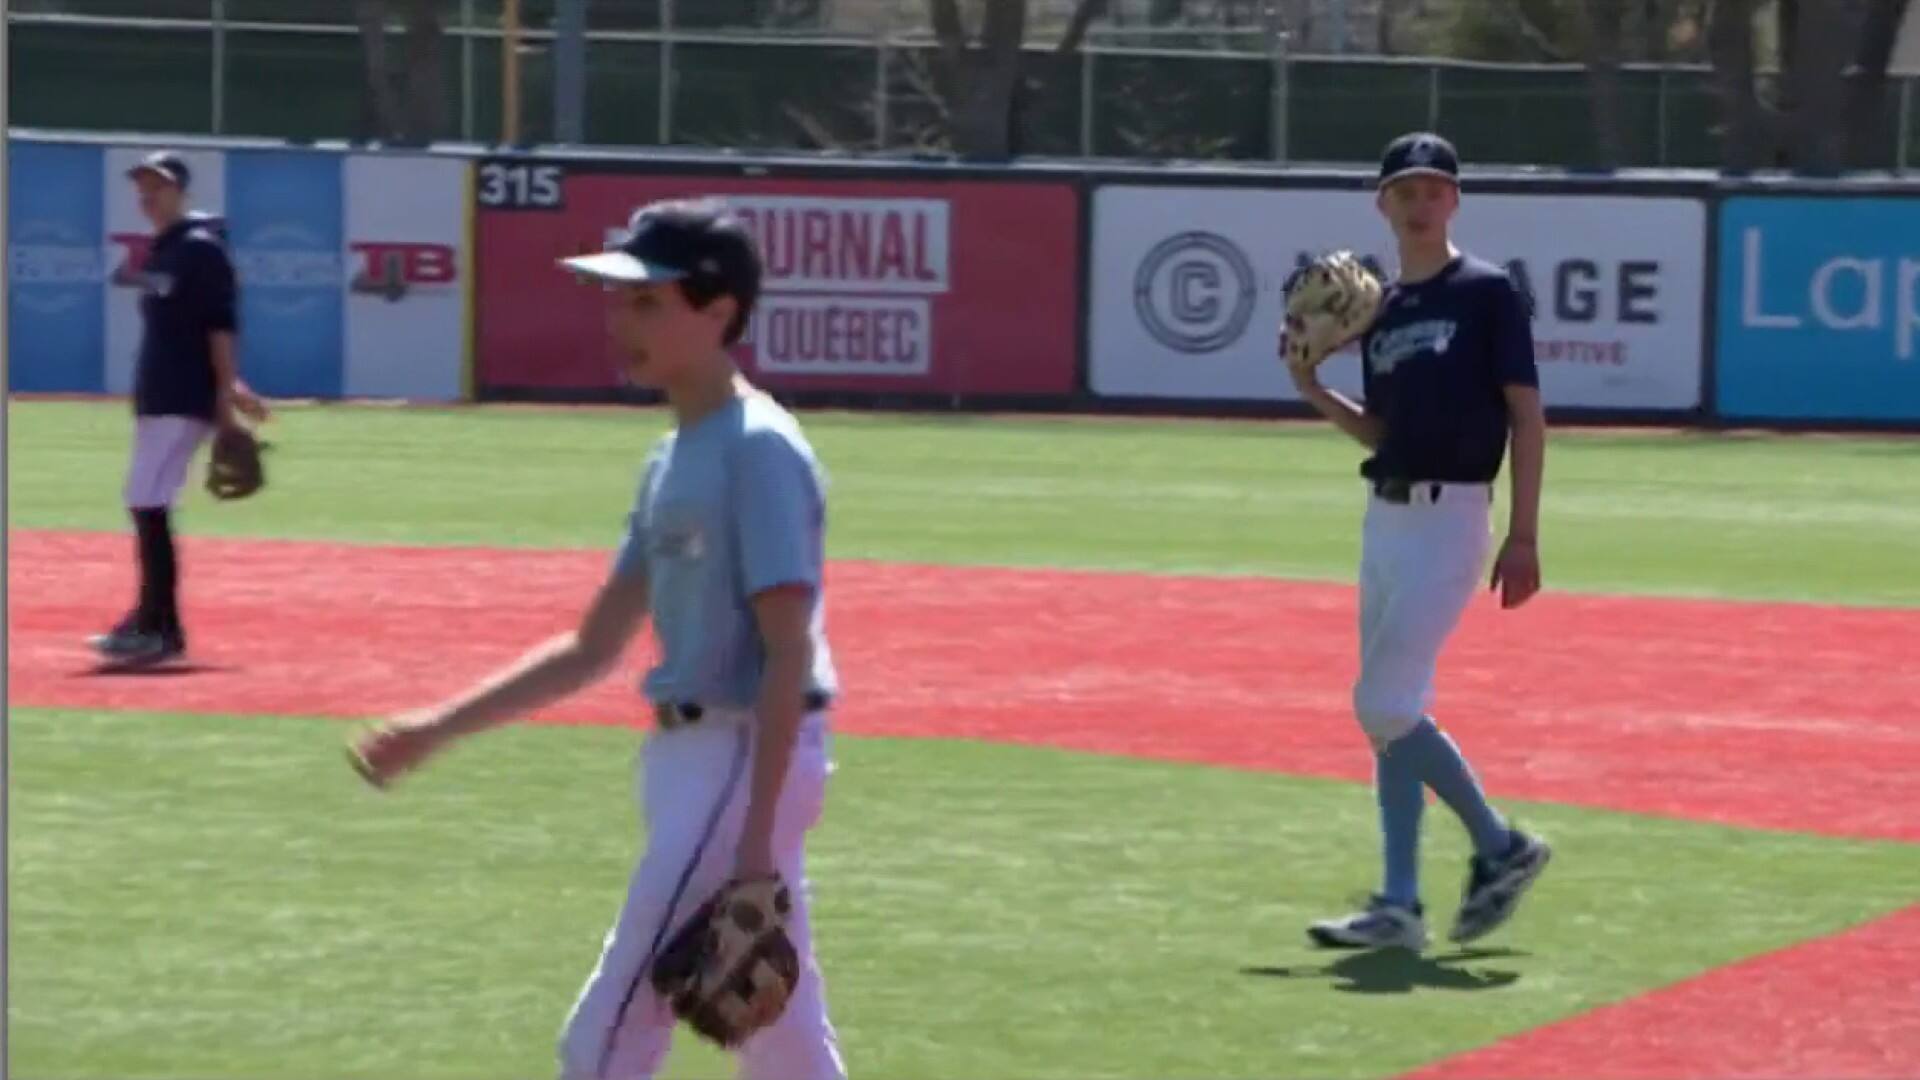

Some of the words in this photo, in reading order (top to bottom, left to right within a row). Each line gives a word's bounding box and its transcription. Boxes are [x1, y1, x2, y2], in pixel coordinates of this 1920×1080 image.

[480, 166, 558, 205] 315
[738, 207, 938, 281] URNAL
[1506, 259, 1658, 322] AGE
[769, 306, 917, 362] QUÉBEC
